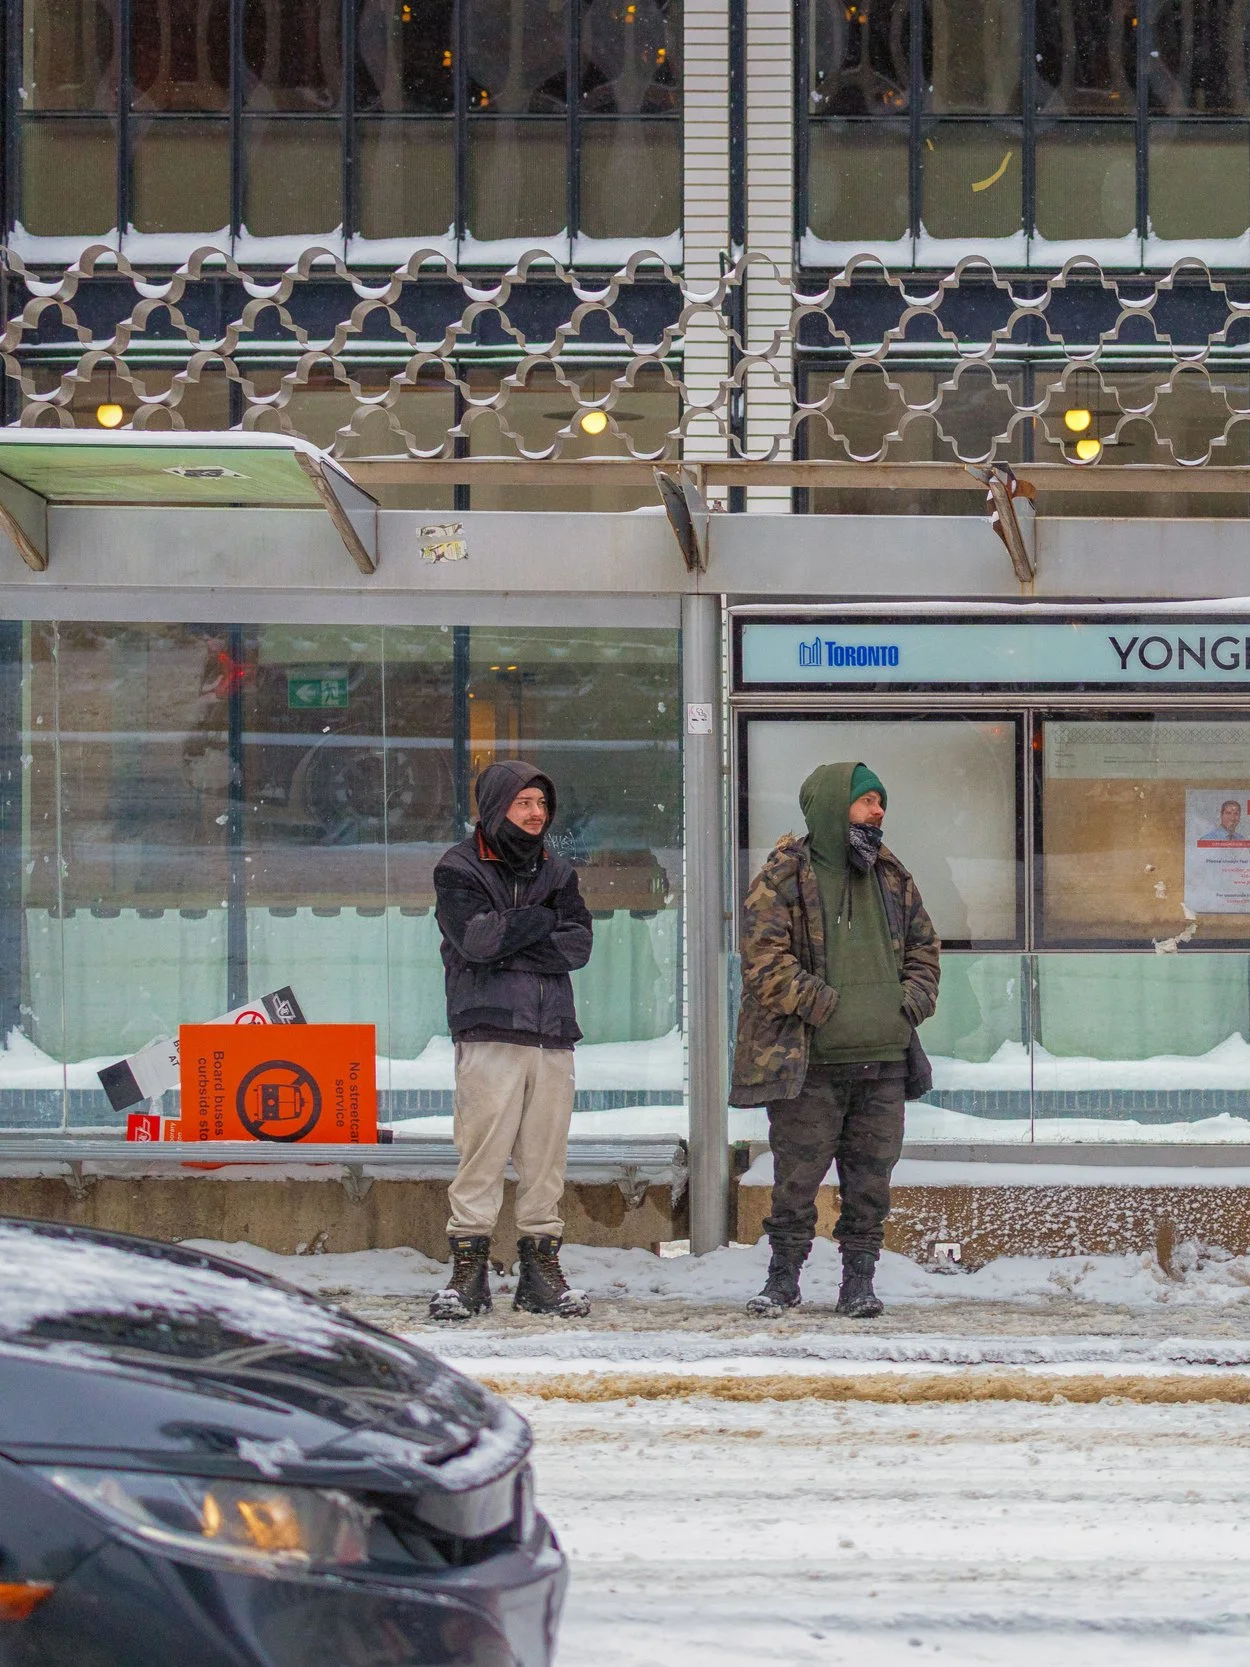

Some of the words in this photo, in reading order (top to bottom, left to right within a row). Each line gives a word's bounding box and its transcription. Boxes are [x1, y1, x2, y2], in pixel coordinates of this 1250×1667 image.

[824, 641, 899, 667] TORONTO
[168, 1055, 180, 1067] AT
[213, 1051, 225, 1091] Board
[349, 1062, 361, 1081] No
[198, 1057, 210, 1116] curbside
[335, 1079, 346, 1128] service
[199, 1120, 210, 1141] sto
[214, 1096, 225, 1136] buses
[349, 1084, 361, 1144] streetcar
